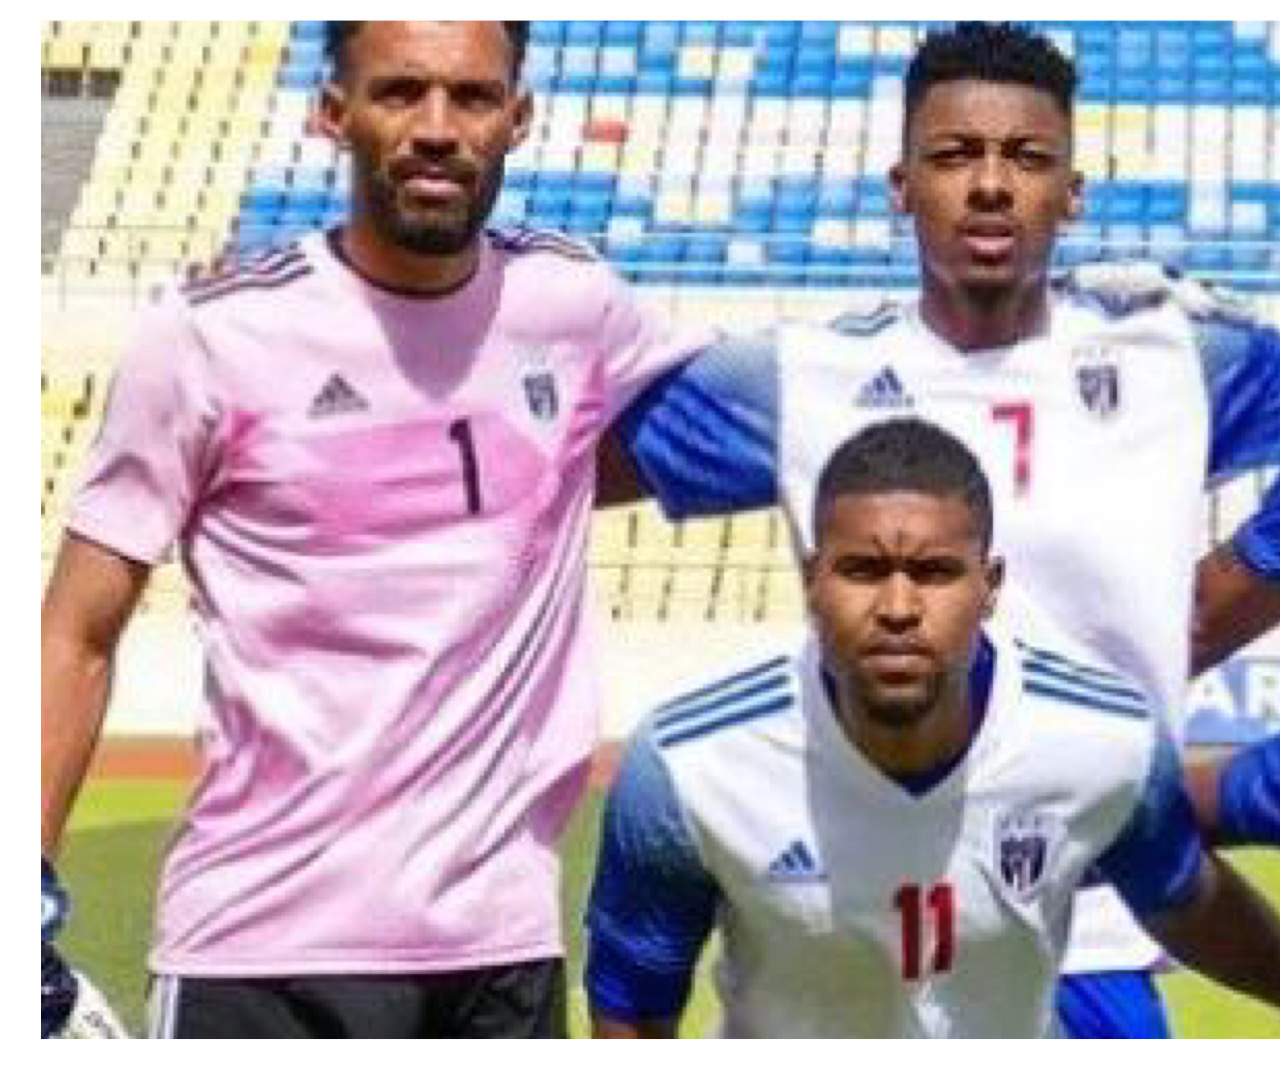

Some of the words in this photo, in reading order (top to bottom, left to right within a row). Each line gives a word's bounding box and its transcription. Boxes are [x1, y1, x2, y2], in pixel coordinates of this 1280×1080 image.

[449, 417, 481, 515] 1
[992, 401, 1034, 495] 7
[895, 884, 956, 980] 11
